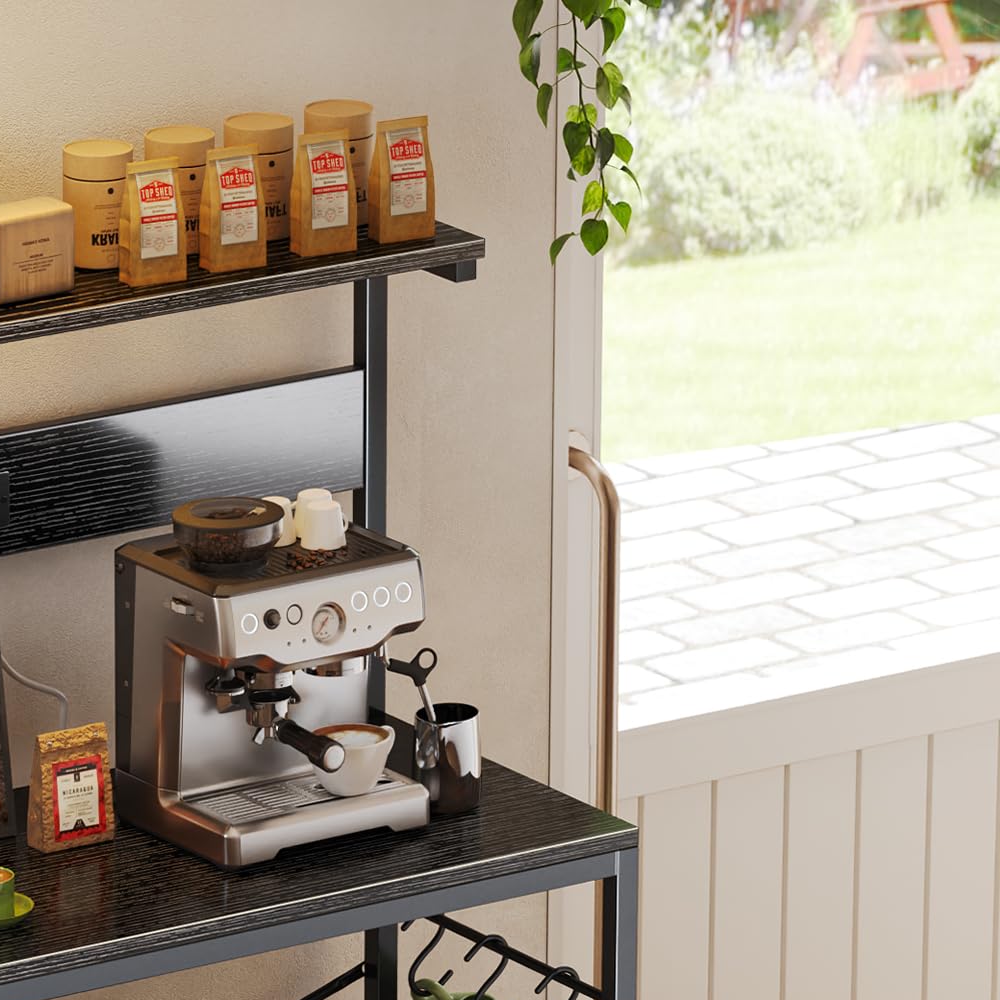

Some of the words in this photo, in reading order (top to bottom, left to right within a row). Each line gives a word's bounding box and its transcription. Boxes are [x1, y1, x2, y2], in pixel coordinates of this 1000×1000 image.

[391, 145, 404, 158] TOP
[404, 143, 423, 155] SHED
[312, 158, 325, 171] TOP
[325, 156, 344, 168] SHED
[222, 174, 235, 188] TOP
[236, 171, 255, 184] SHED
[140, 188, 154, 201] TOP
[154, 184, 175, 197] SHED
